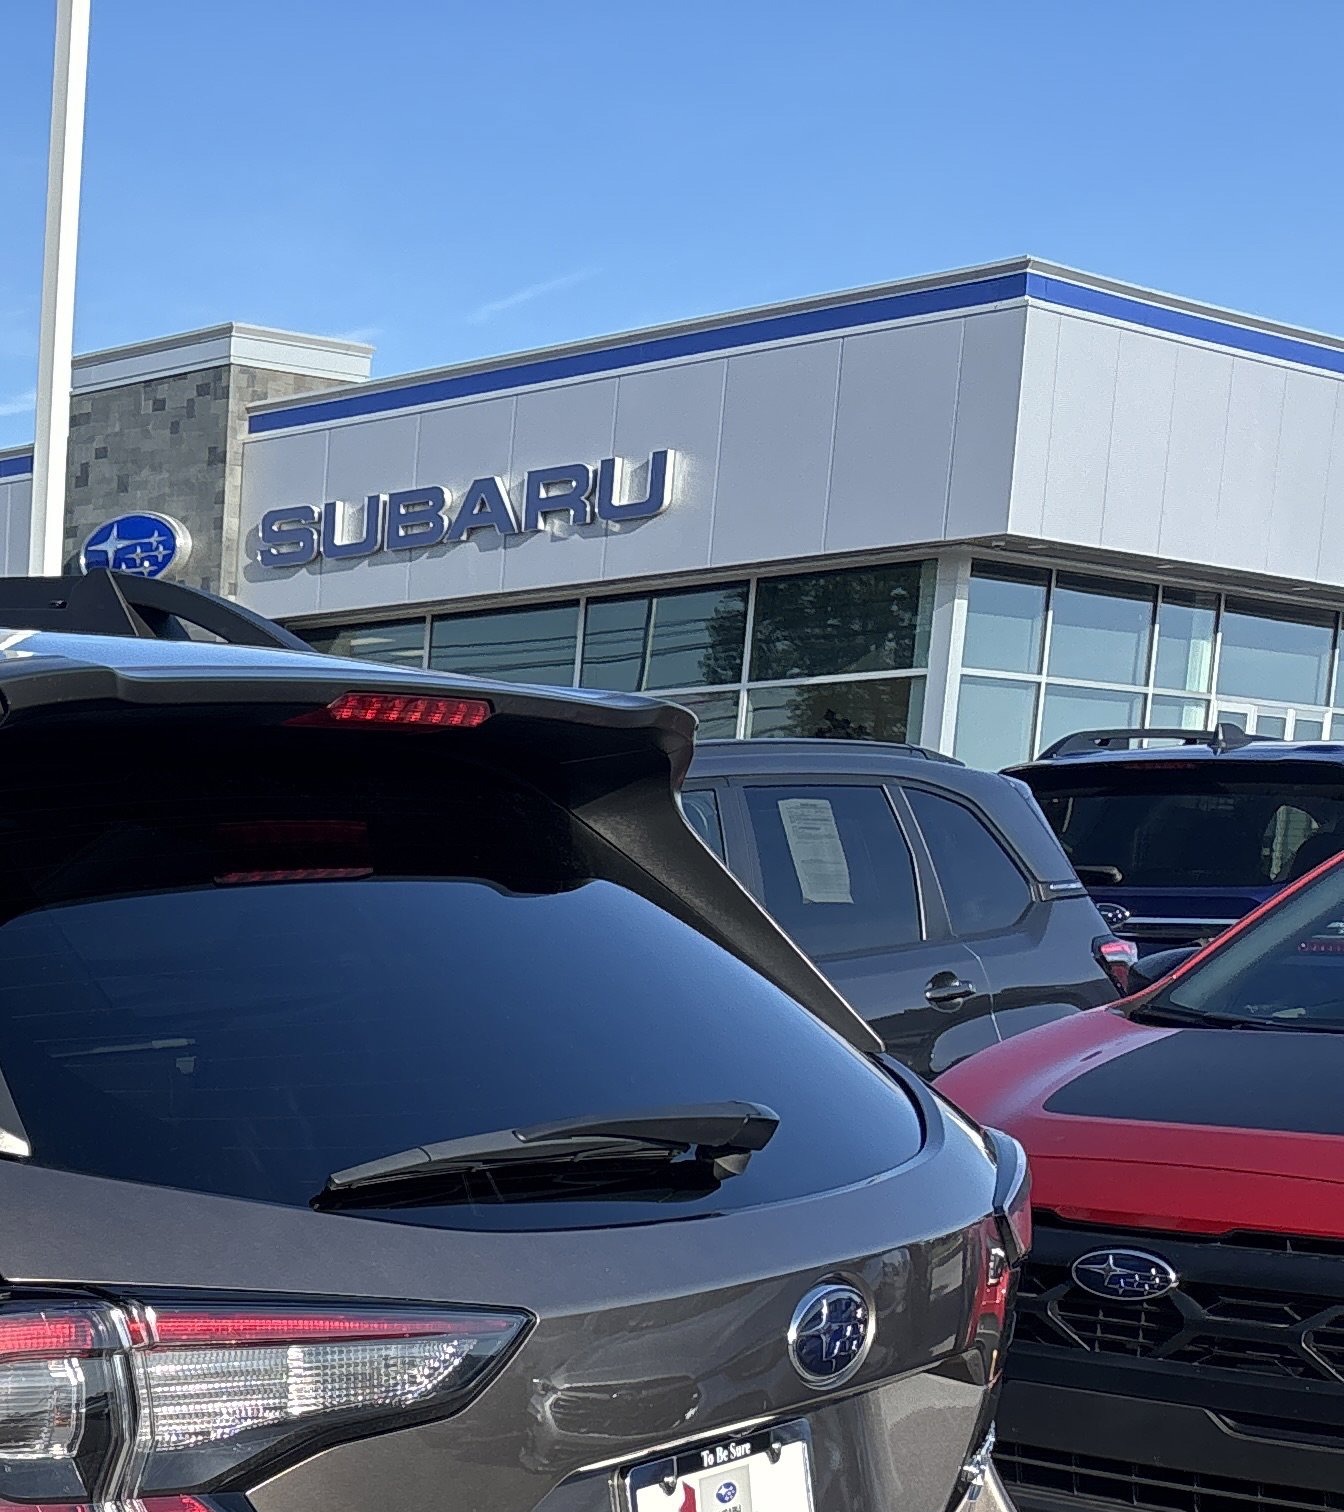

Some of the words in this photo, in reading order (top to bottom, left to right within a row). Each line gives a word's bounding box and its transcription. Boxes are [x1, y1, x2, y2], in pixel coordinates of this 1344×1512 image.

[257, 450, 674, 568] SUBARU
[701, 1450, 714, 1467] To
[716, 1446, 728, 1464] Be
[728, 1442, 751, 1460] Sure
